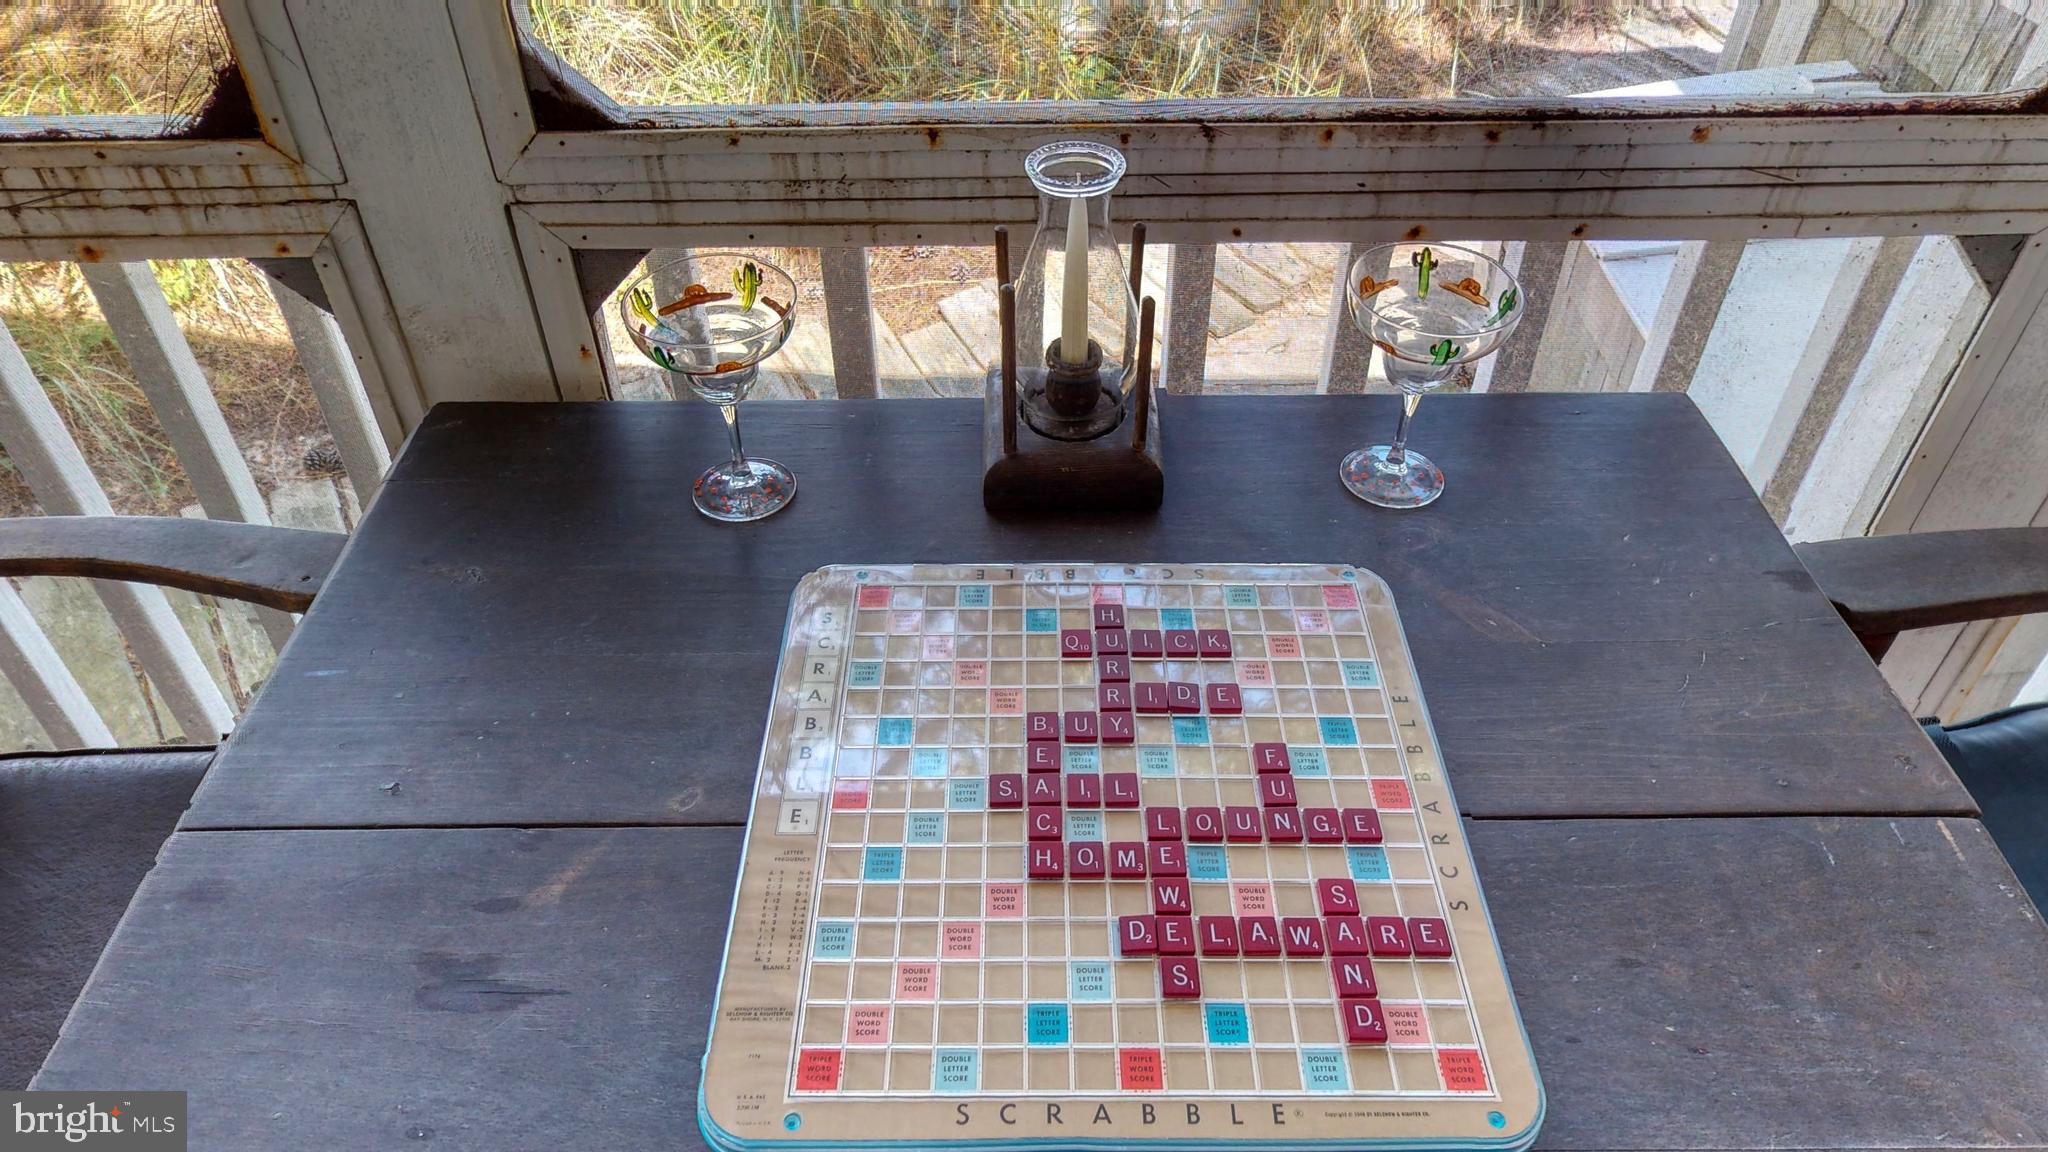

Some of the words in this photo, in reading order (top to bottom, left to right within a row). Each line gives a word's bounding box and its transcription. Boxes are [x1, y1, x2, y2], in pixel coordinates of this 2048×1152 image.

[1064, 633, 1228, 651] QUICK
[1101, 609, 1127, 733] HURRY
[1106, 686, 1235, 704] RIDE
[1034, 715, 1127, 733] BUY
[999, 779, 1131, 797] SAIL
[1034, 715, 1055, 868] BEACH
[1264, 749, 1294, 831] FUN
[1392, 693, 1469, 911] SCRABBLE
[1158, 814, 1374, 833] LOUNGE
[1036, 847, 1178, 868] HOME
[1129, 920, 1442, 946] DELAWARE
[1331, 885, 1380, 1028] SAND
[941, 1055, 972, 1063] DOUBLE
[1307, 1055, 1338, 1063] DOUBLE
[956, 1103, 1286, 1126] SCRABBLE
